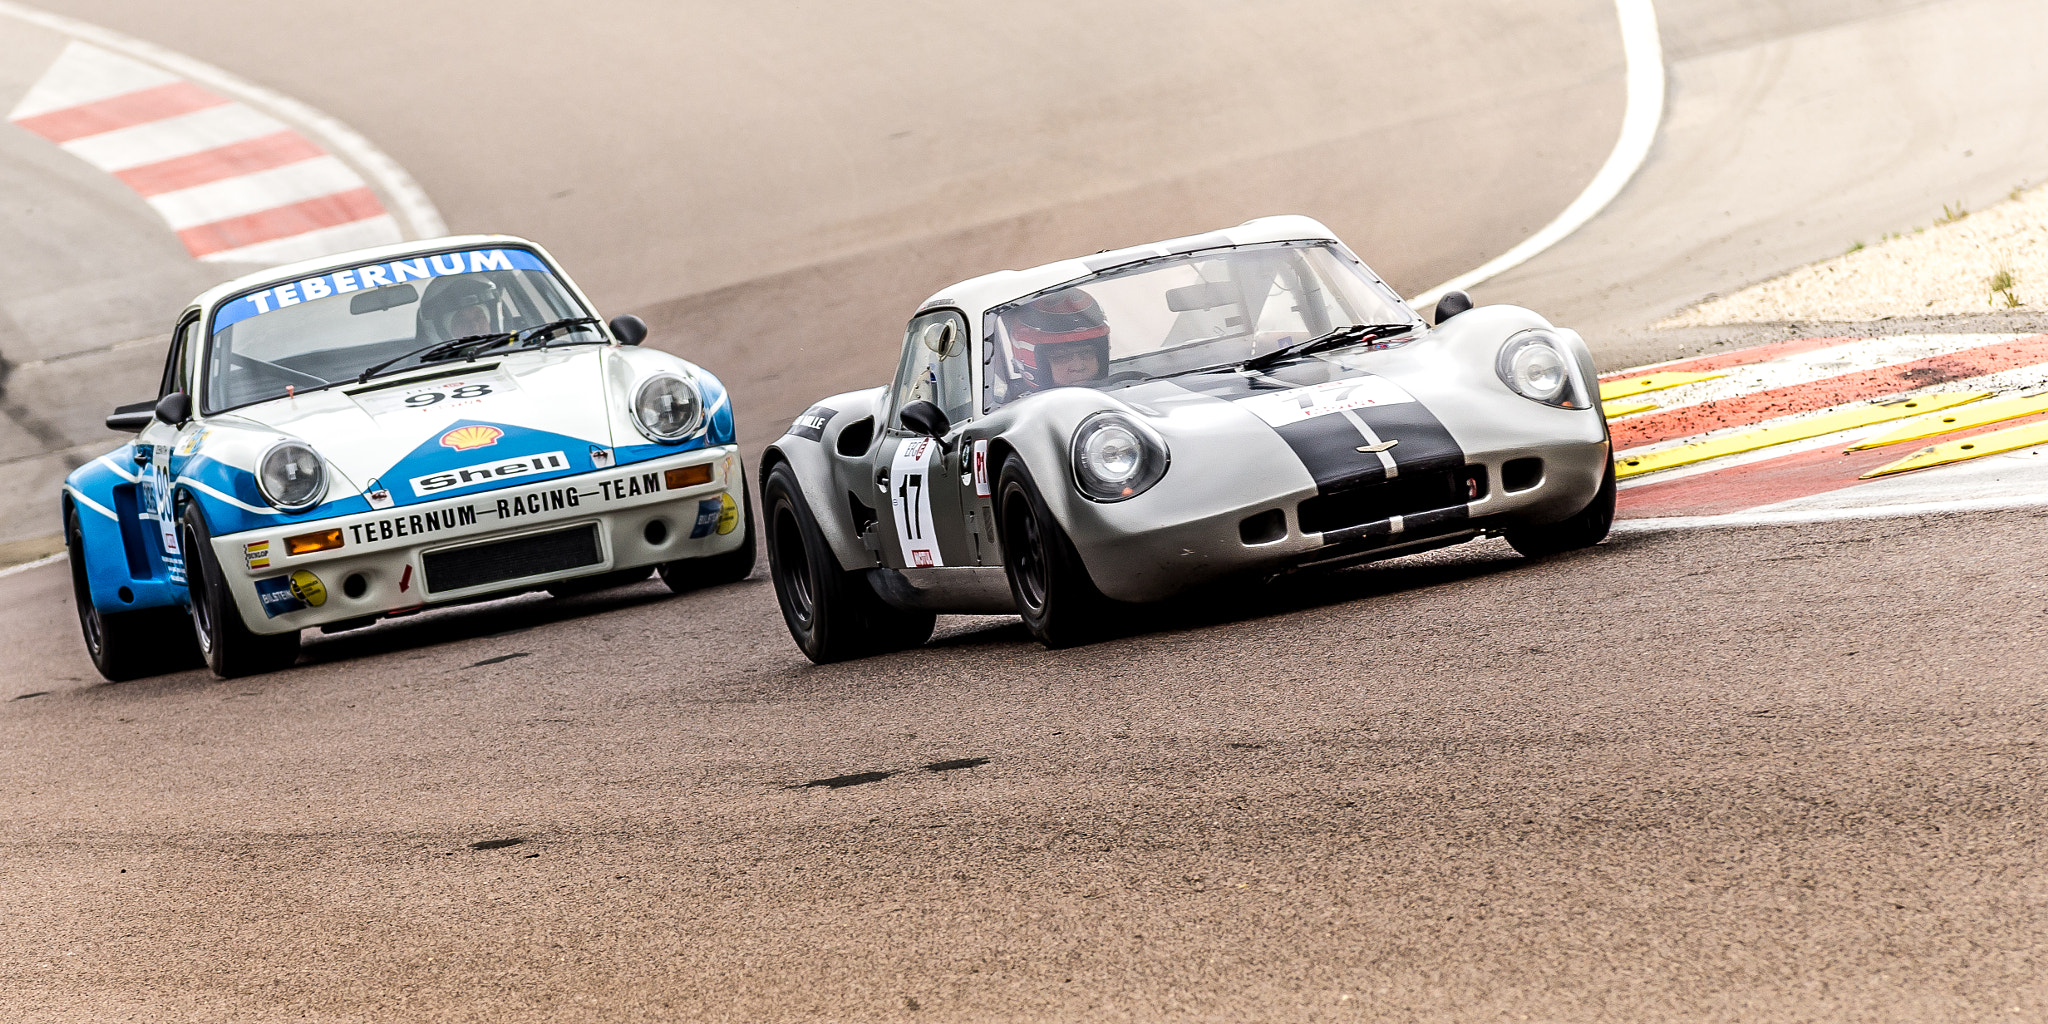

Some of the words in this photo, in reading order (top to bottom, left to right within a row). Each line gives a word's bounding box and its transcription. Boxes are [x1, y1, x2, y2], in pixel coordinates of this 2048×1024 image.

[246, 250, 514, 315] TEBERNUM
[404, 384, 493, 408] 98
[1282, 383, 1363, 409] 17
[419, 455, 562, 491] Shell
[156, 464, 172, 523] 98
[899, 474, 922, 539] 17
[246, 550, 268, 560] DUNLOP
